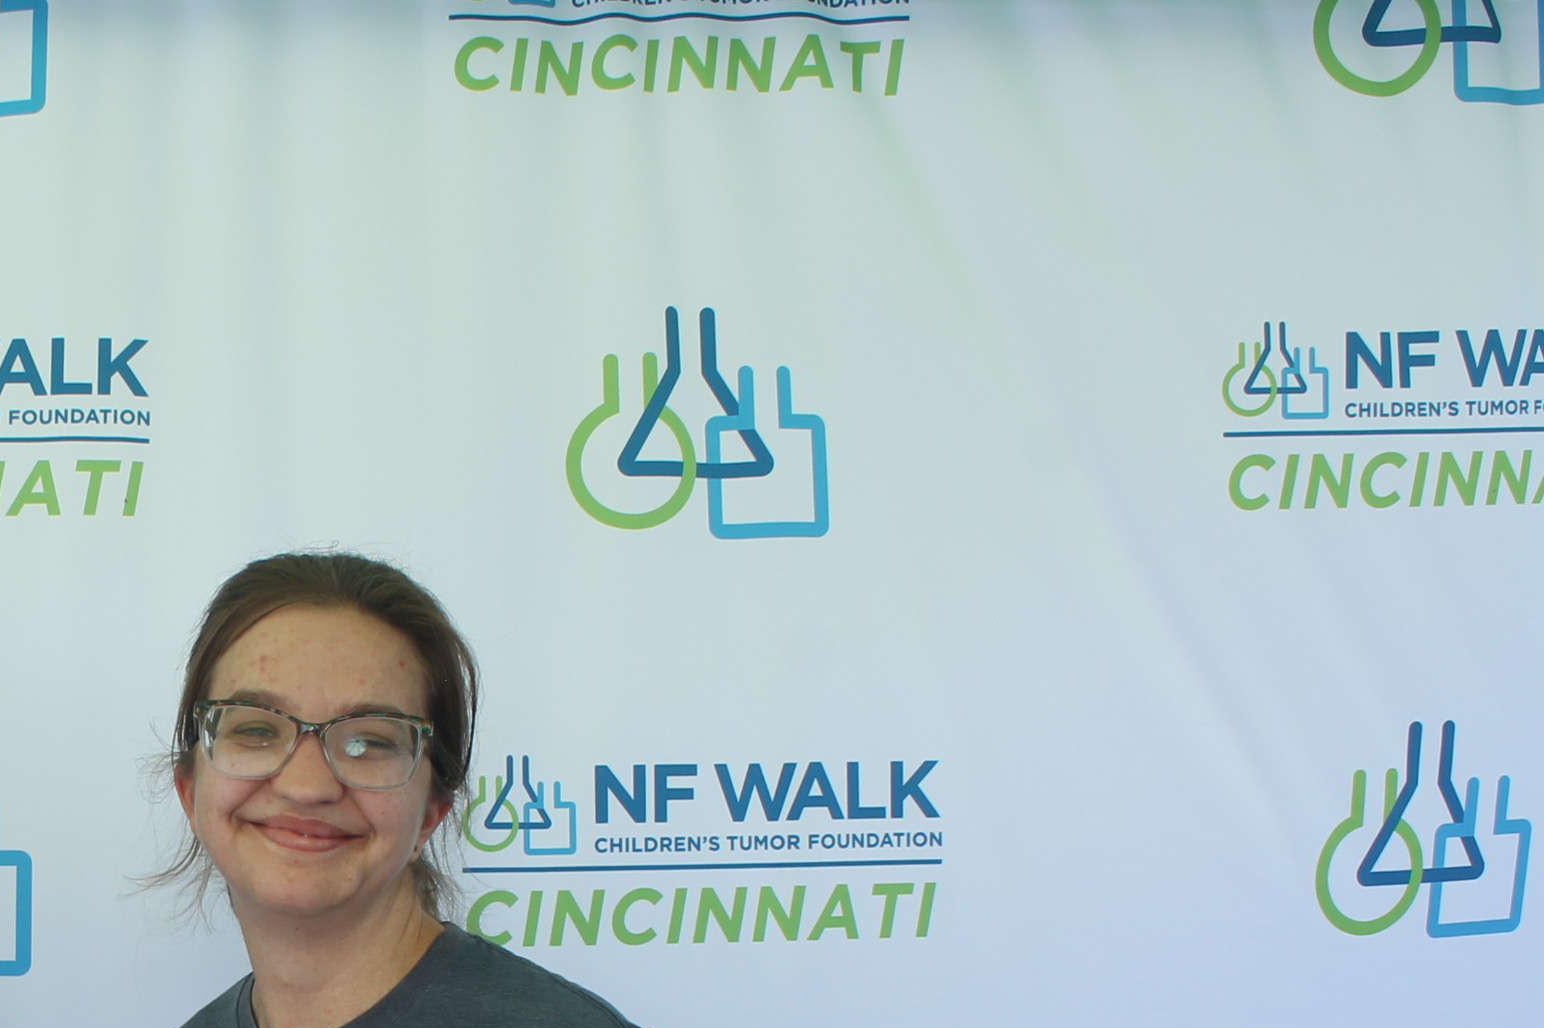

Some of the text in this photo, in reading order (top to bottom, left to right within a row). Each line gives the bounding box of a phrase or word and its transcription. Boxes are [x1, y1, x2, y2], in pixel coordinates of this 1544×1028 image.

[454, 34, 905, 96] CINCINNATI
[1345, 331, 1440, 389] NF
[8, 409, 151, 426] FOUNDATION
[1345, 401, 1459, 418] CHILDREN'S
[1465, 400, 1529, 416] TUMOR
[1228, 450, 1544, 511] CINCINN
[594, 759, 941, 824] NF WALK
[594, 831, 943, 853] CHILDREN'S TUMOR FOUNDATION
[466, 882, 937, 947] CINCINNATI
